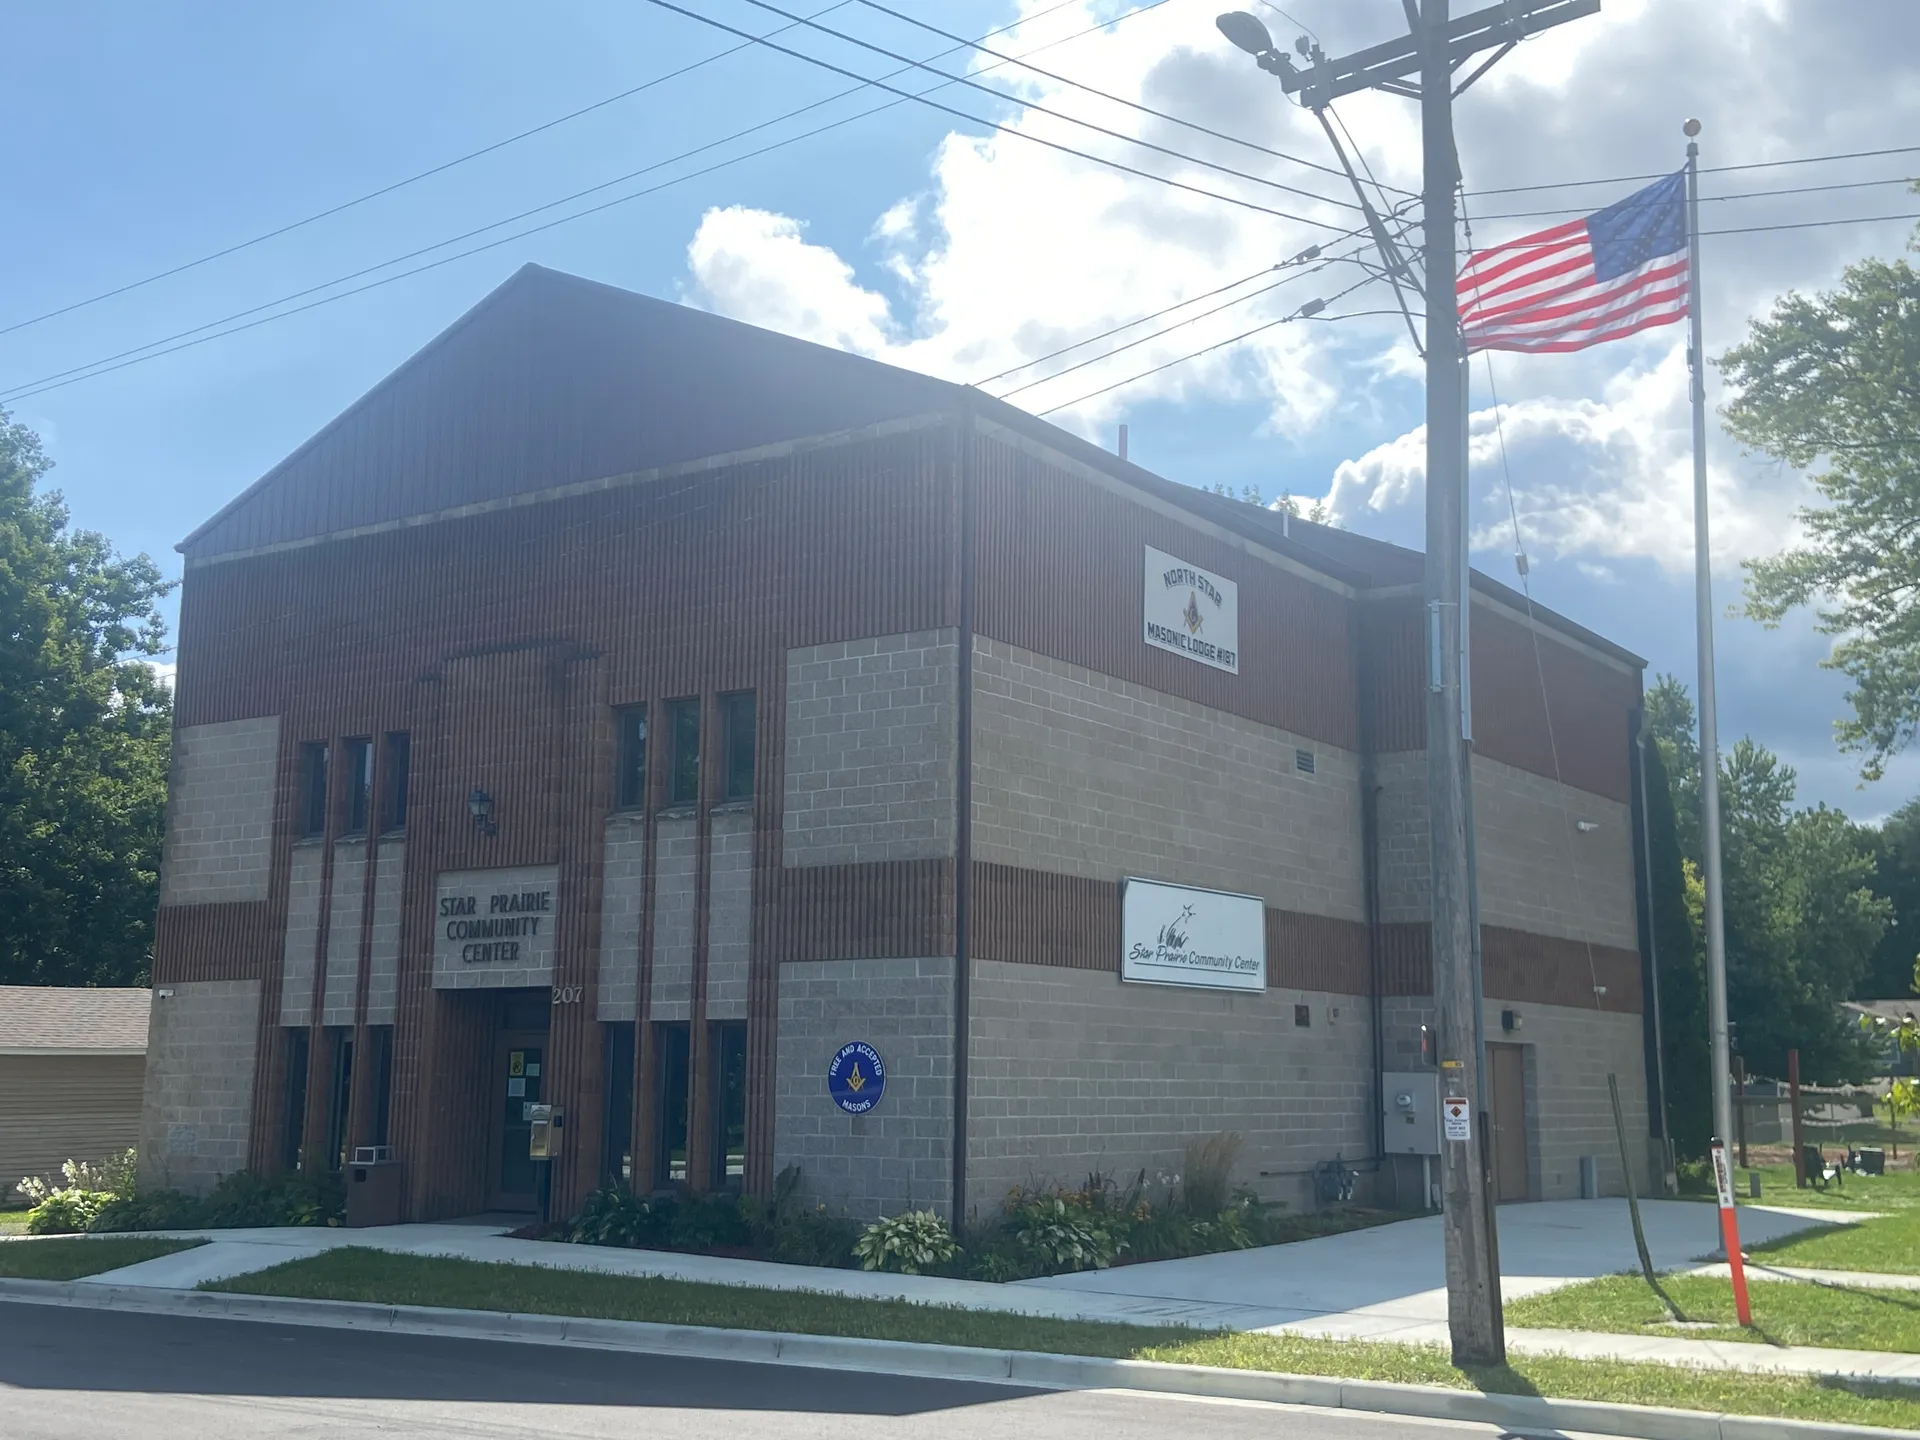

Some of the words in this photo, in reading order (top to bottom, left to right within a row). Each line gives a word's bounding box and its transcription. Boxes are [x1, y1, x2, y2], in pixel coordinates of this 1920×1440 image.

[1163, 568, 1196, 588] NORTH
[1198, 575, 1222, 608] STAR
[1147, 622, 1186, 650] MASONIC
[1187, 638, 1215, 660] LODGE
[1217, 648, 1236, 667] #187
[439, 896, 476, 917] STAR
[490, 891, 550, 914] PRAIRIE
[446, 917, 540, 940] COMMUNITY
[462, 941, 520, 963] CENTER
[1129, 943, 1153, 960] Star
[1155, 945, 1187, 963] Prairie
[1189, 951, 1233, 970] Community
[1234, 956, 1260, 971] Center
[552, 986, 584, 1004] 207
[830, 1055, 842, 1076] FREE
[841, 1044, 855, 1058] AND
[857, 1044, 882, 1076] ACCEPTED
[842, 1099, 871, 1112] MASONS
